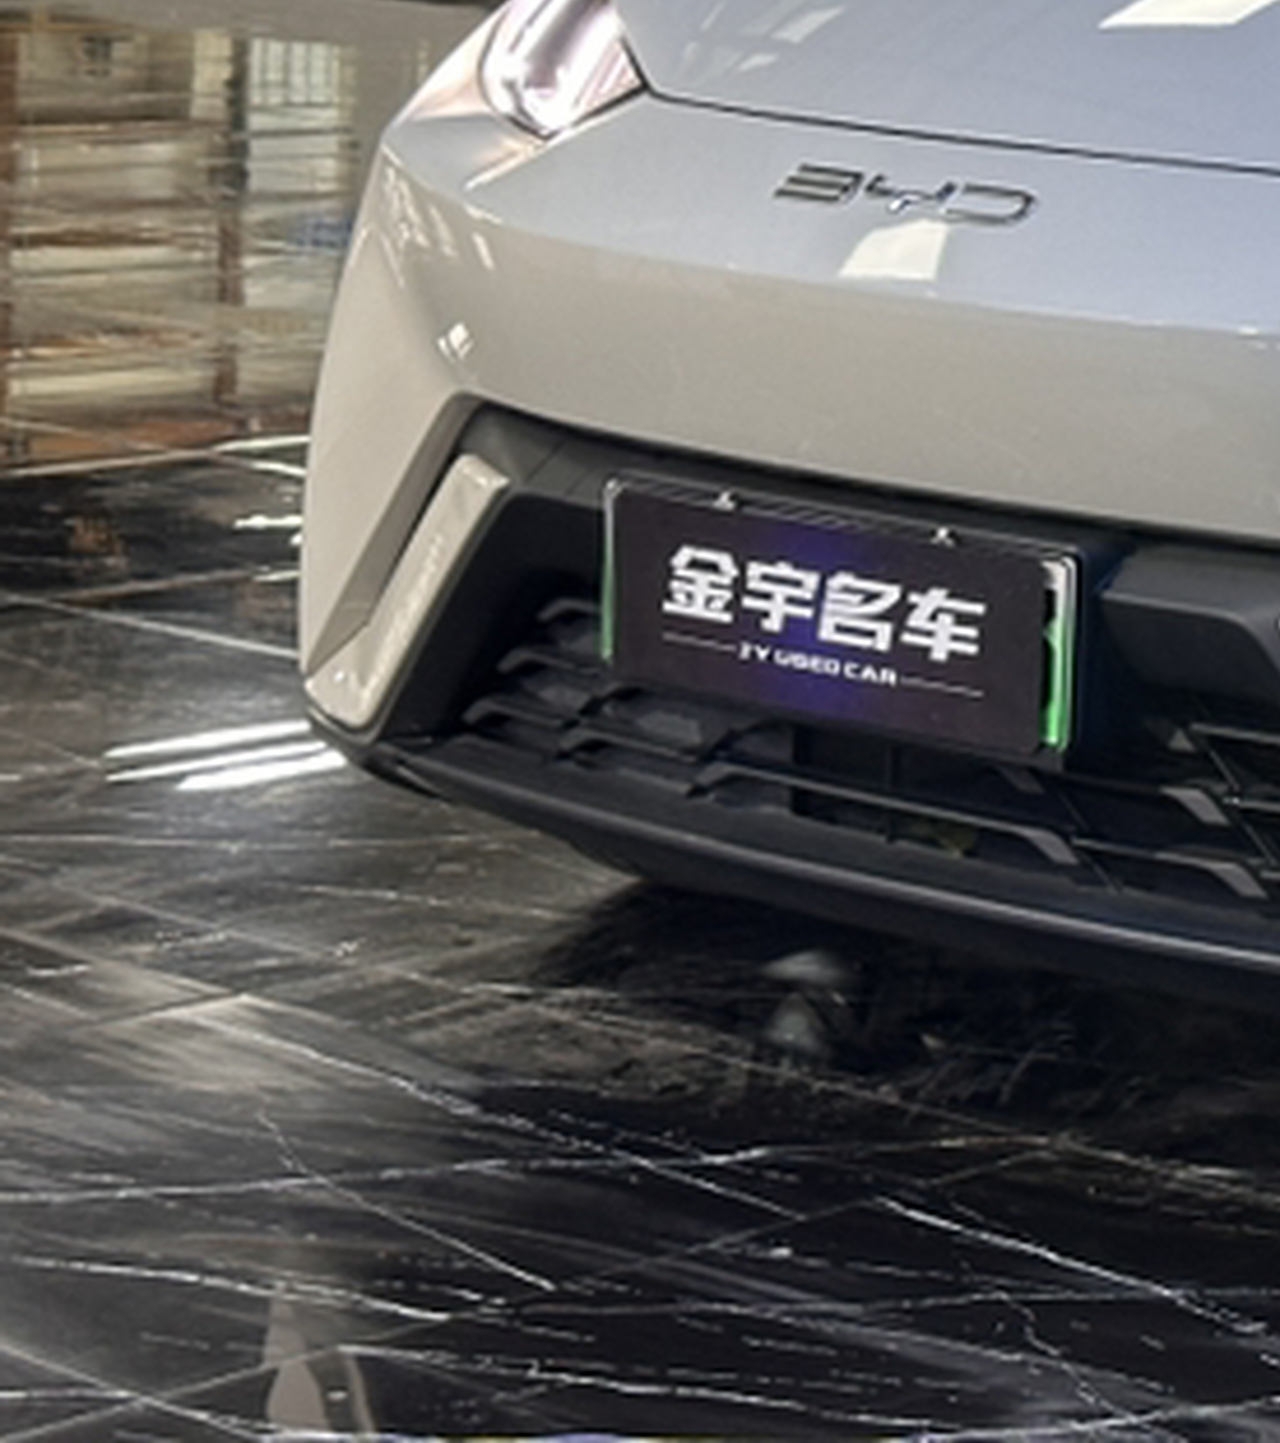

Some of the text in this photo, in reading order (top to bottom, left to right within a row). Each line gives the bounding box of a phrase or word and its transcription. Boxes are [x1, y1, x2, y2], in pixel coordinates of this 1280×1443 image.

[774, 163, 1037, 225] BYD
[662, 545, 986, 663] 金宇名车
[773, 649, 840, 676] USED
[843, 658, 898, 687] CAR
